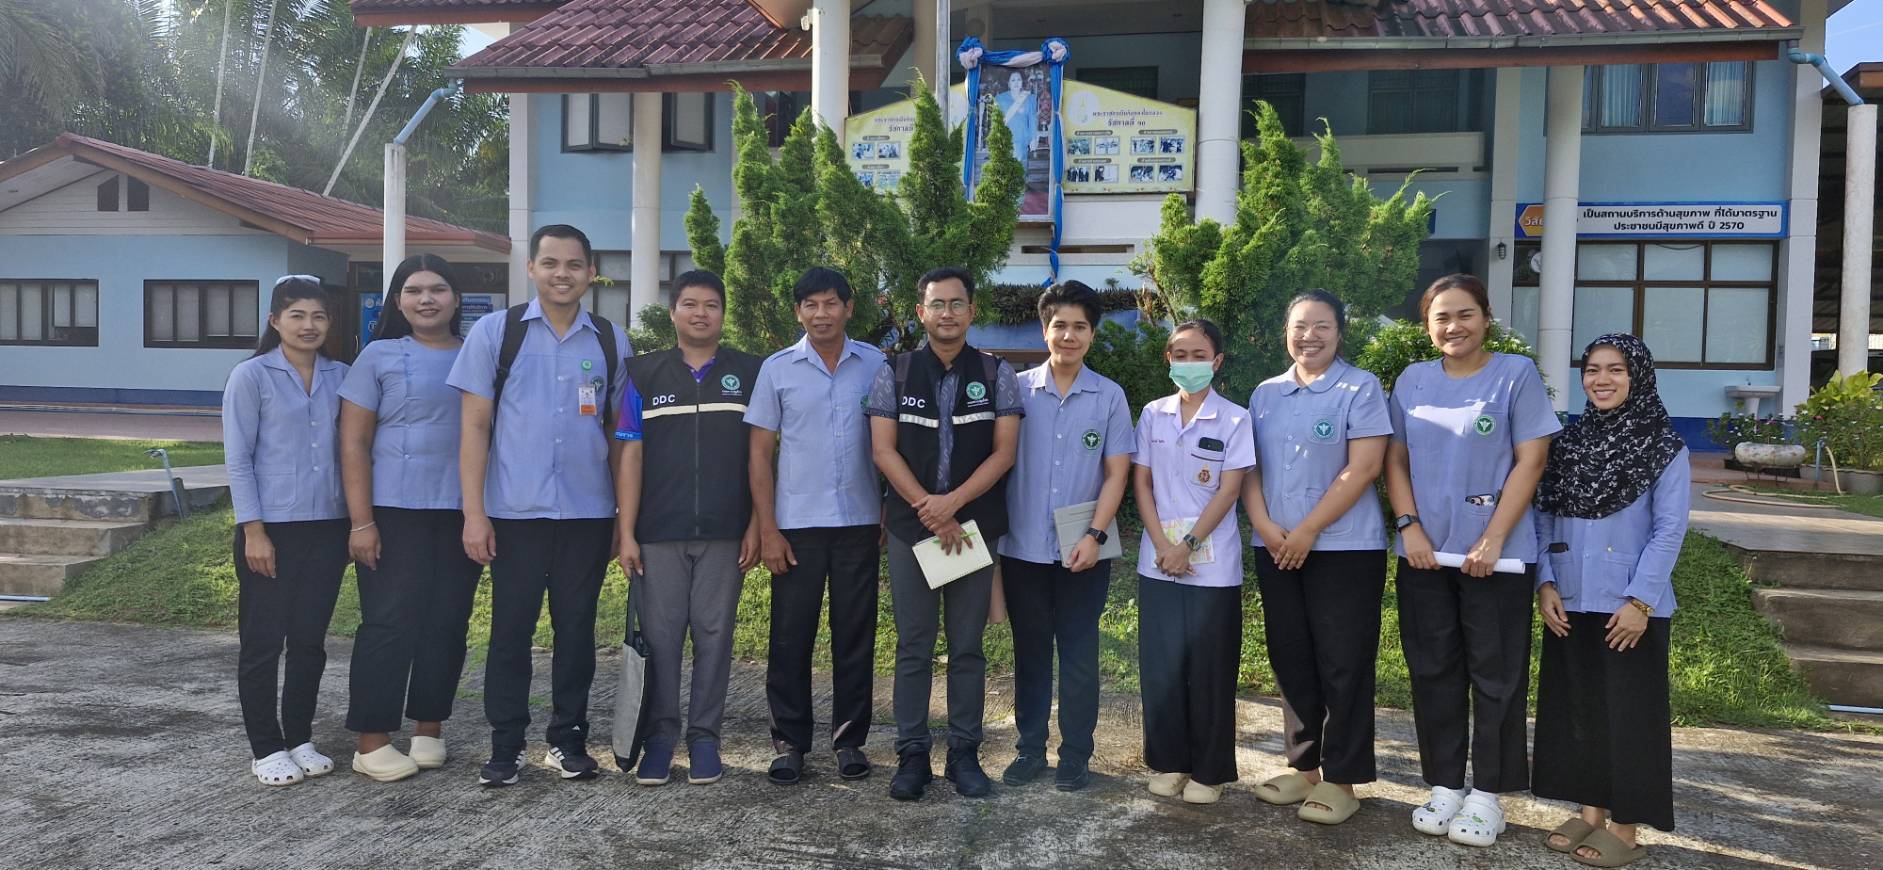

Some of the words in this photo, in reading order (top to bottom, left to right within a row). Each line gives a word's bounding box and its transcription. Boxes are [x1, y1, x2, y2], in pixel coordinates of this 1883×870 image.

[1583, 208, 1710, 219] เป็นสถานบริการด้านสุขภาพ
[1714, 206, 1777, 219] ที่ได้มาตรฐาน
[1614, 221, 1704, 232] ประชาชนมีสุขภาพดี
[1708, 221, 1716, 230] ปี
[1719, 221, 1745, 230] 2570
[652, 394, 676, 406] DDC
[901, 395, 926, 409] DDC
